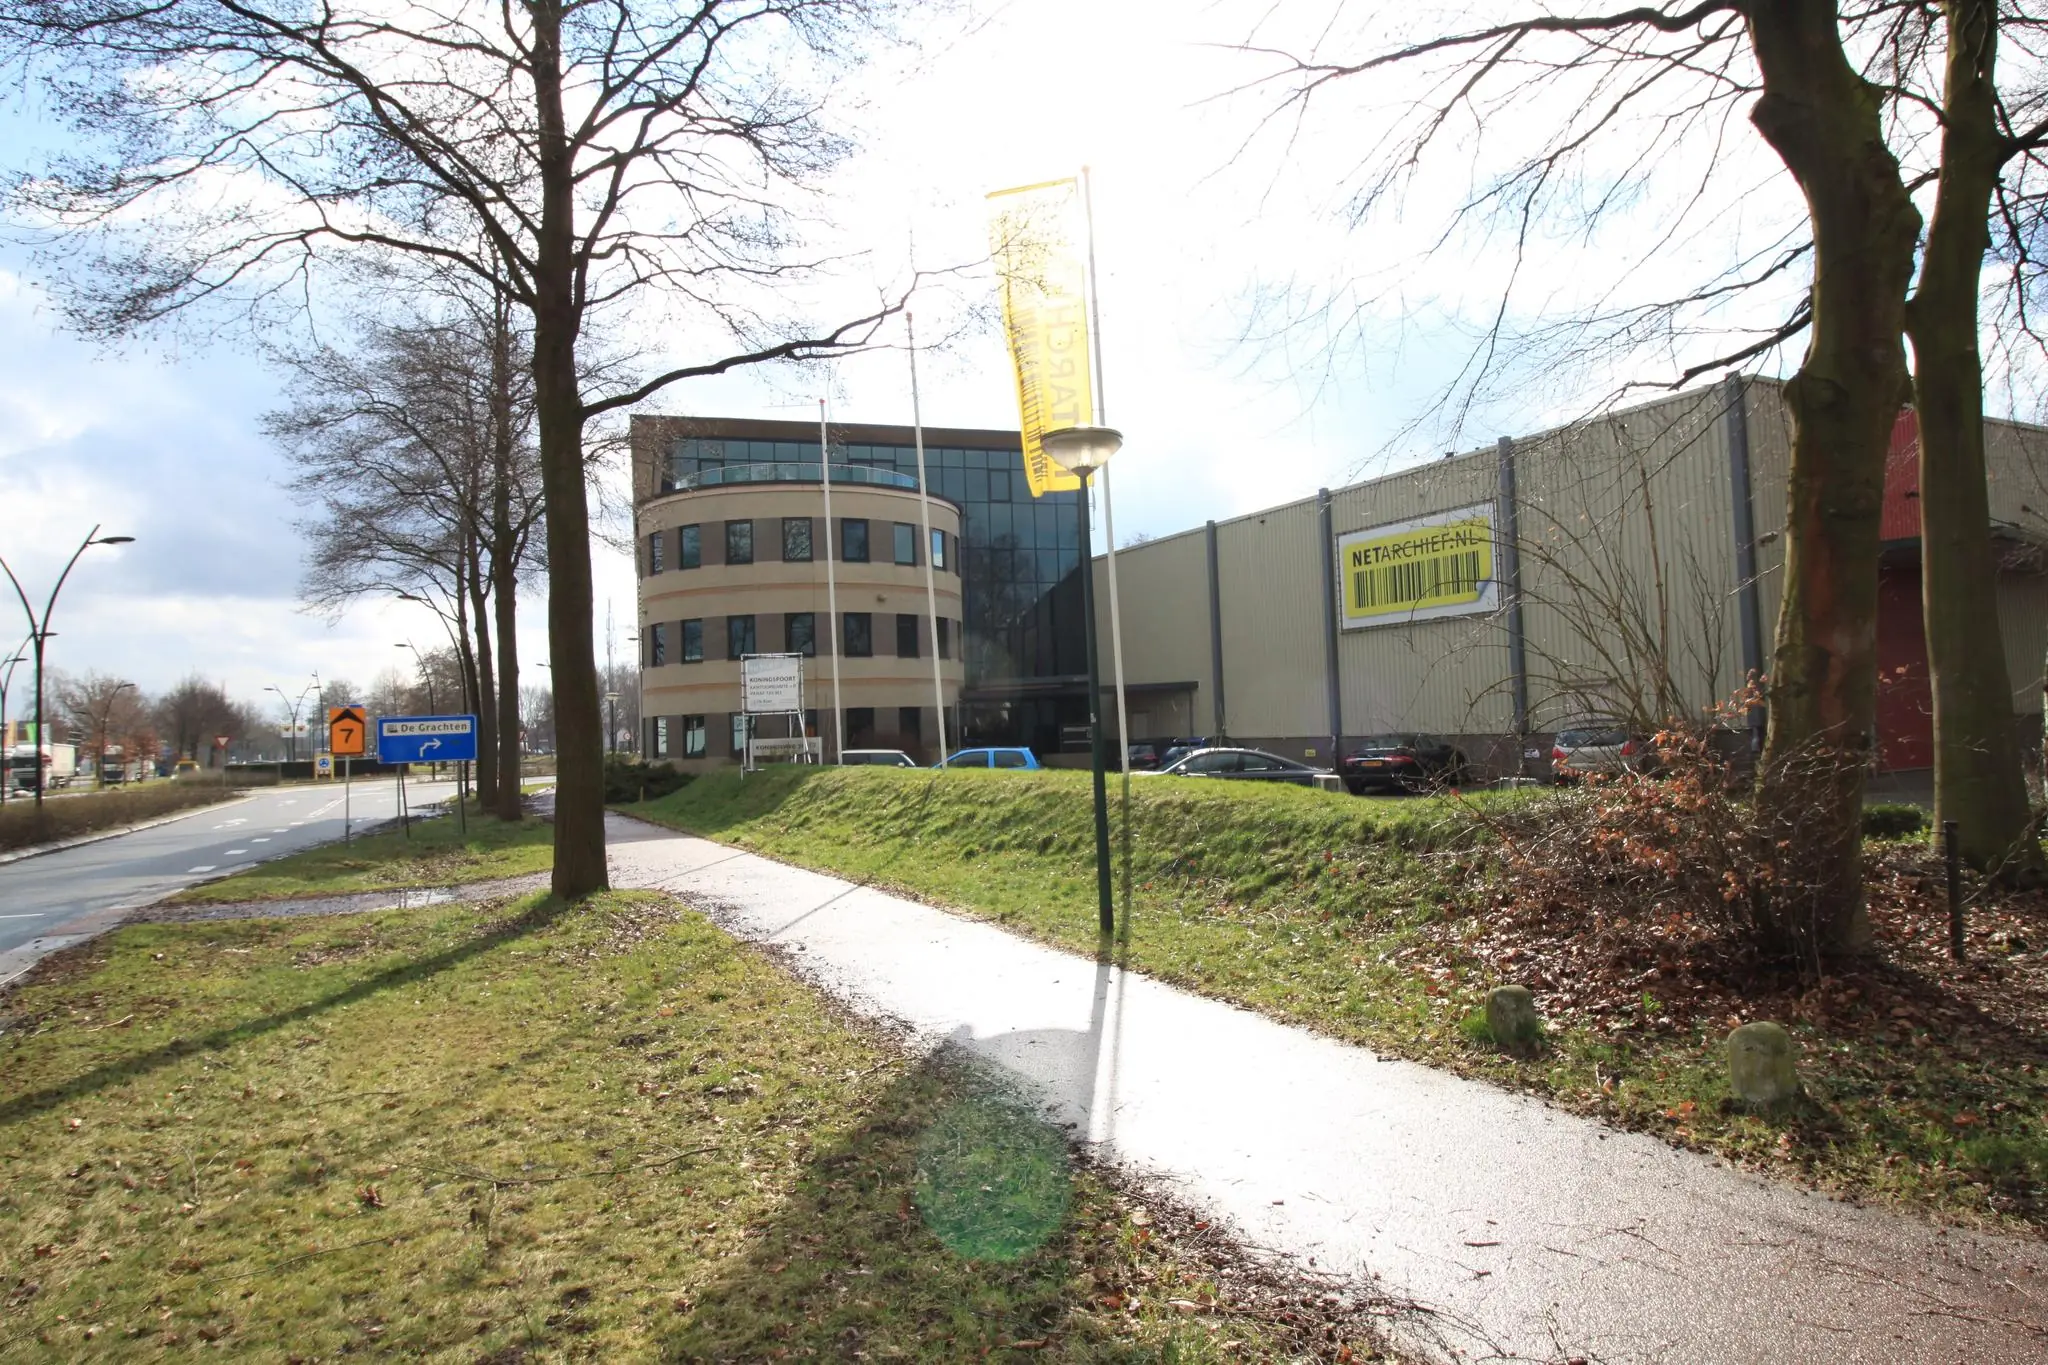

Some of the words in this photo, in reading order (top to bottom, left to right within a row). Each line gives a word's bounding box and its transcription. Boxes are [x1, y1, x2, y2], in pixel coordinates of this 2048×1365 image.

[1352, 528, 1479, 567] NETARCHIEF.NL
[400, 724, 414, 732] De
[418, 722, 468, 732] Grachten
[339, 728, 354, 744] 7
